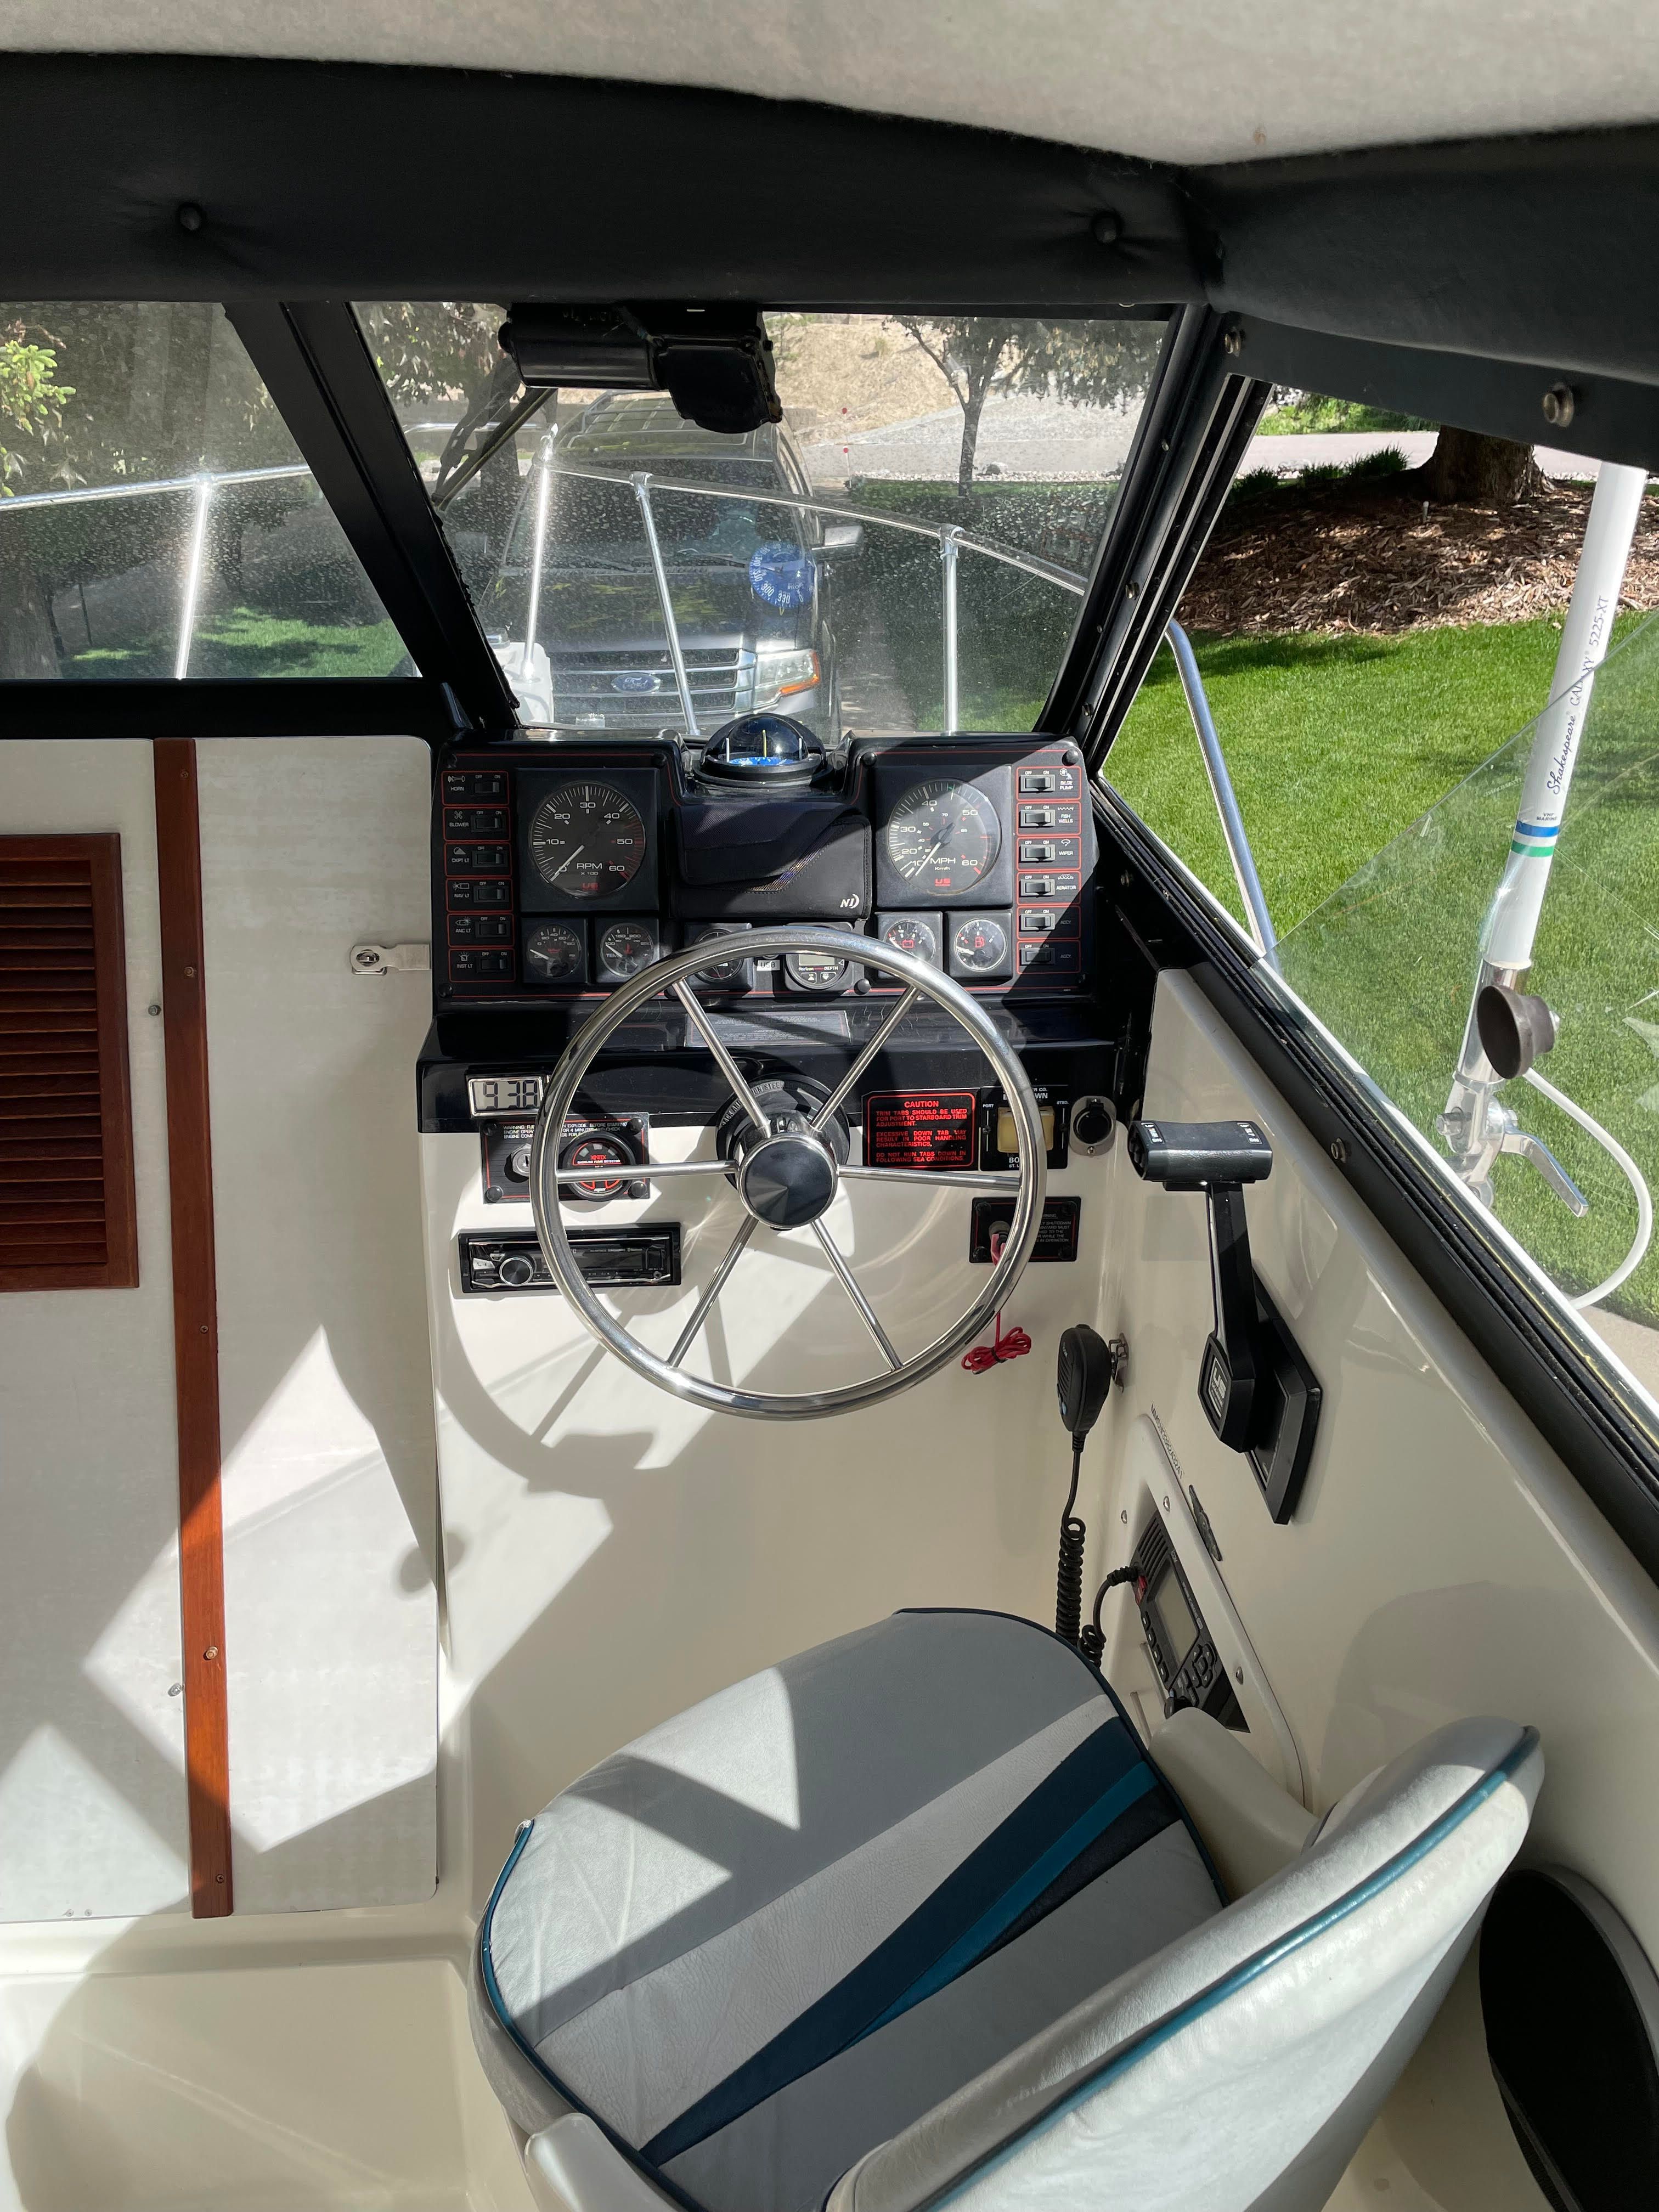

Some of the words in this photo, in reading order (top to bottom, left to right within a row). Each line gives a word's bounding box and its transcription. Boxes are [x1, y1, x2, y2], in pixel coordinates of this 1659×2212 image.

[760, 583, 775, 596] 300
[777, 592, 791, 604] 330
[1589, 595, 1609, 647] 5225-XT
[1212, 1367, 1226, 1399] US
